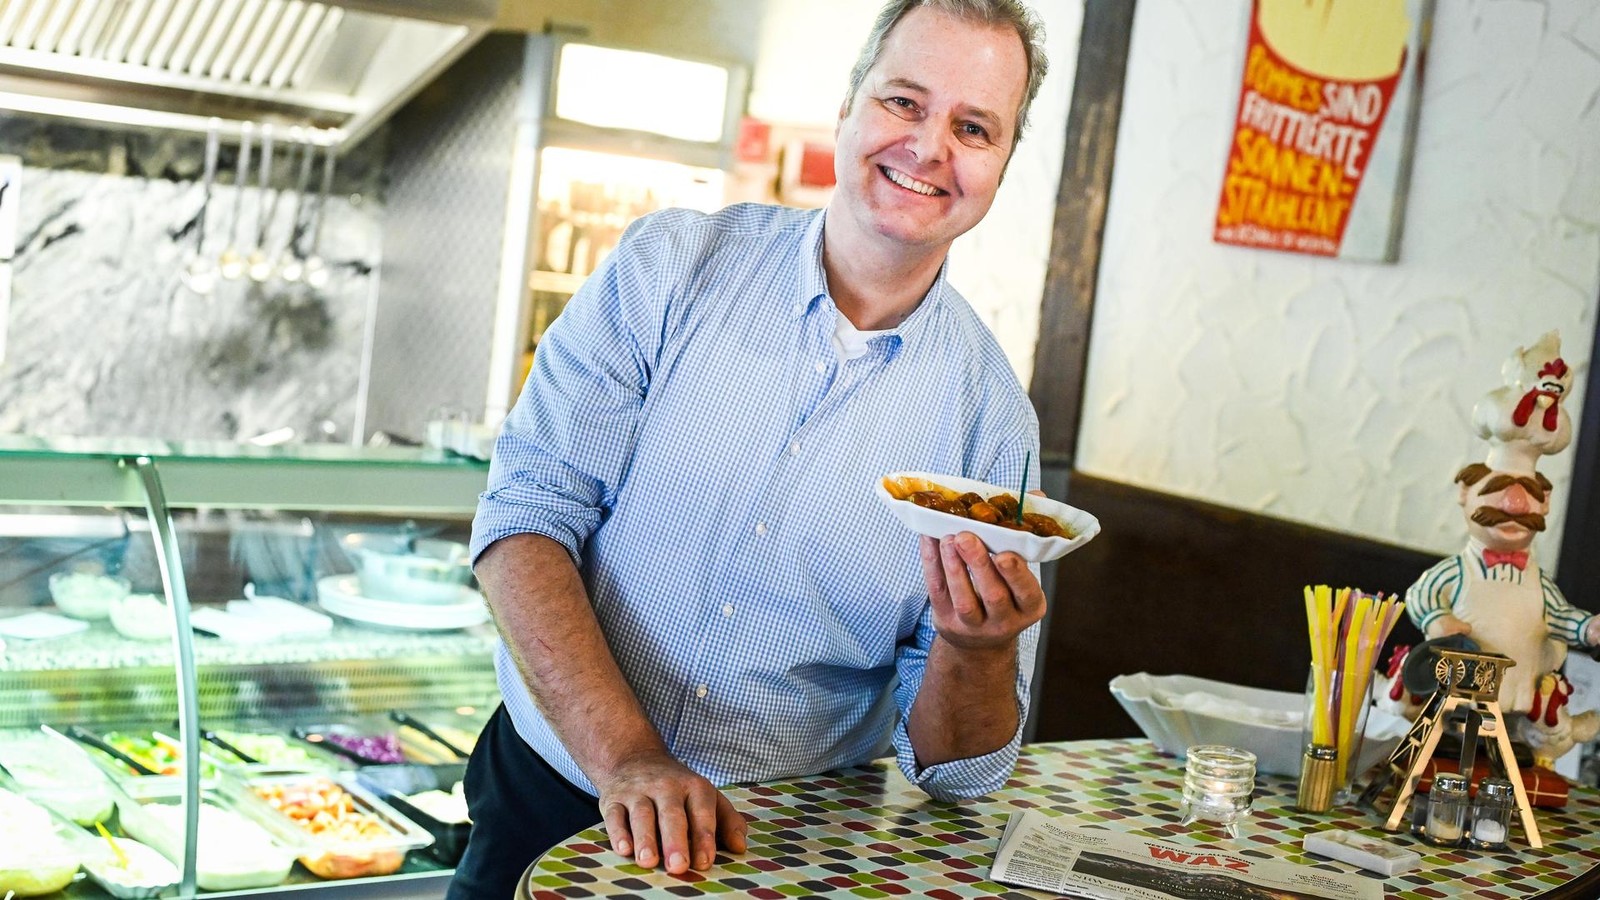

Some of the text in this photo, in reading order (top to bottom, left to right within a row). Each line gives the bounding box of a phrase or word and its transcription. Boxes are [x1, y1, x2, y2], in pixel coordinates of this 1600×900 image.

[1318, 82, 1382, 126] SIND
[1240, 90, 1369, 178] FRITTIERTE
[1231, 128, 1353, 197] SONNEN-
[1144, 842, 1204, 857] WESTDEUTSCHE
[1207, 853, 1255, 866] ALLGEMEINE
[1148, 846, 1250, 874] WAZ
[1072, 874, 1106, 885] NRW
